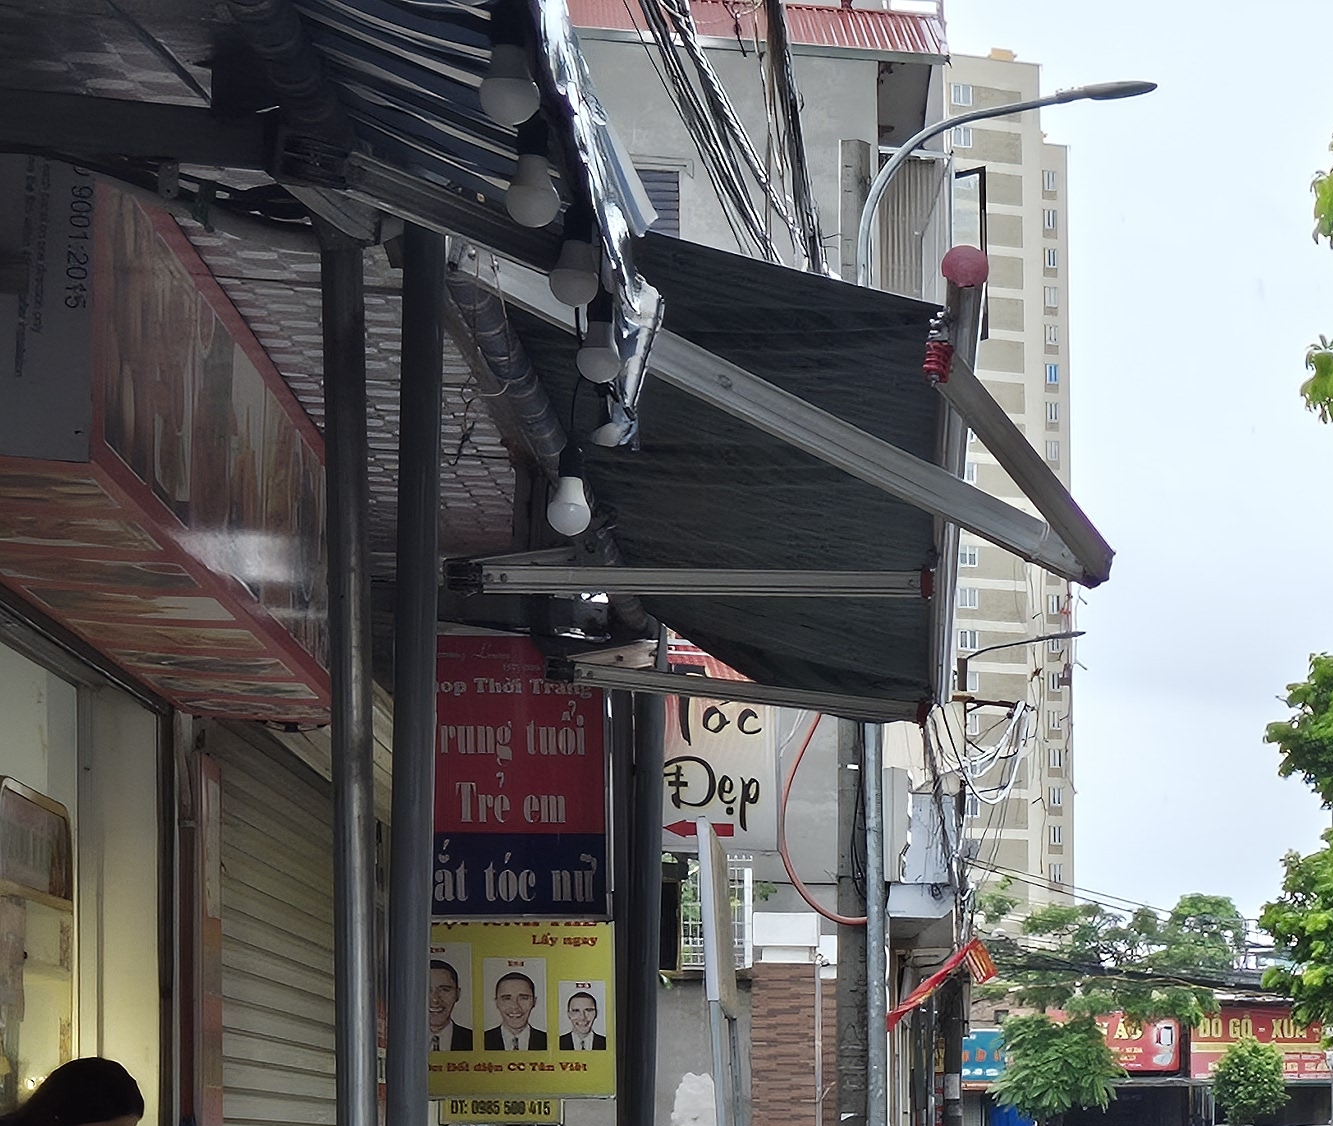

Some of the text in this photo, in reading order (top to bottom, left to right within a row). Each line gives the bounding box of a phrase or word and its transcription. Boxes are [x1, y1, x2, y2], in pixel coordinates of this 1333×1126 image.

[434, 681, 467, 696] op
[440, 700, 586, 765] rung tuổi
[455, 771, 567, 823] Trẻ em
[663, 755, 760, 832] Đẹp
[434, 838, 468, 902] ắt
[484, 851, 537, 902] tóc
